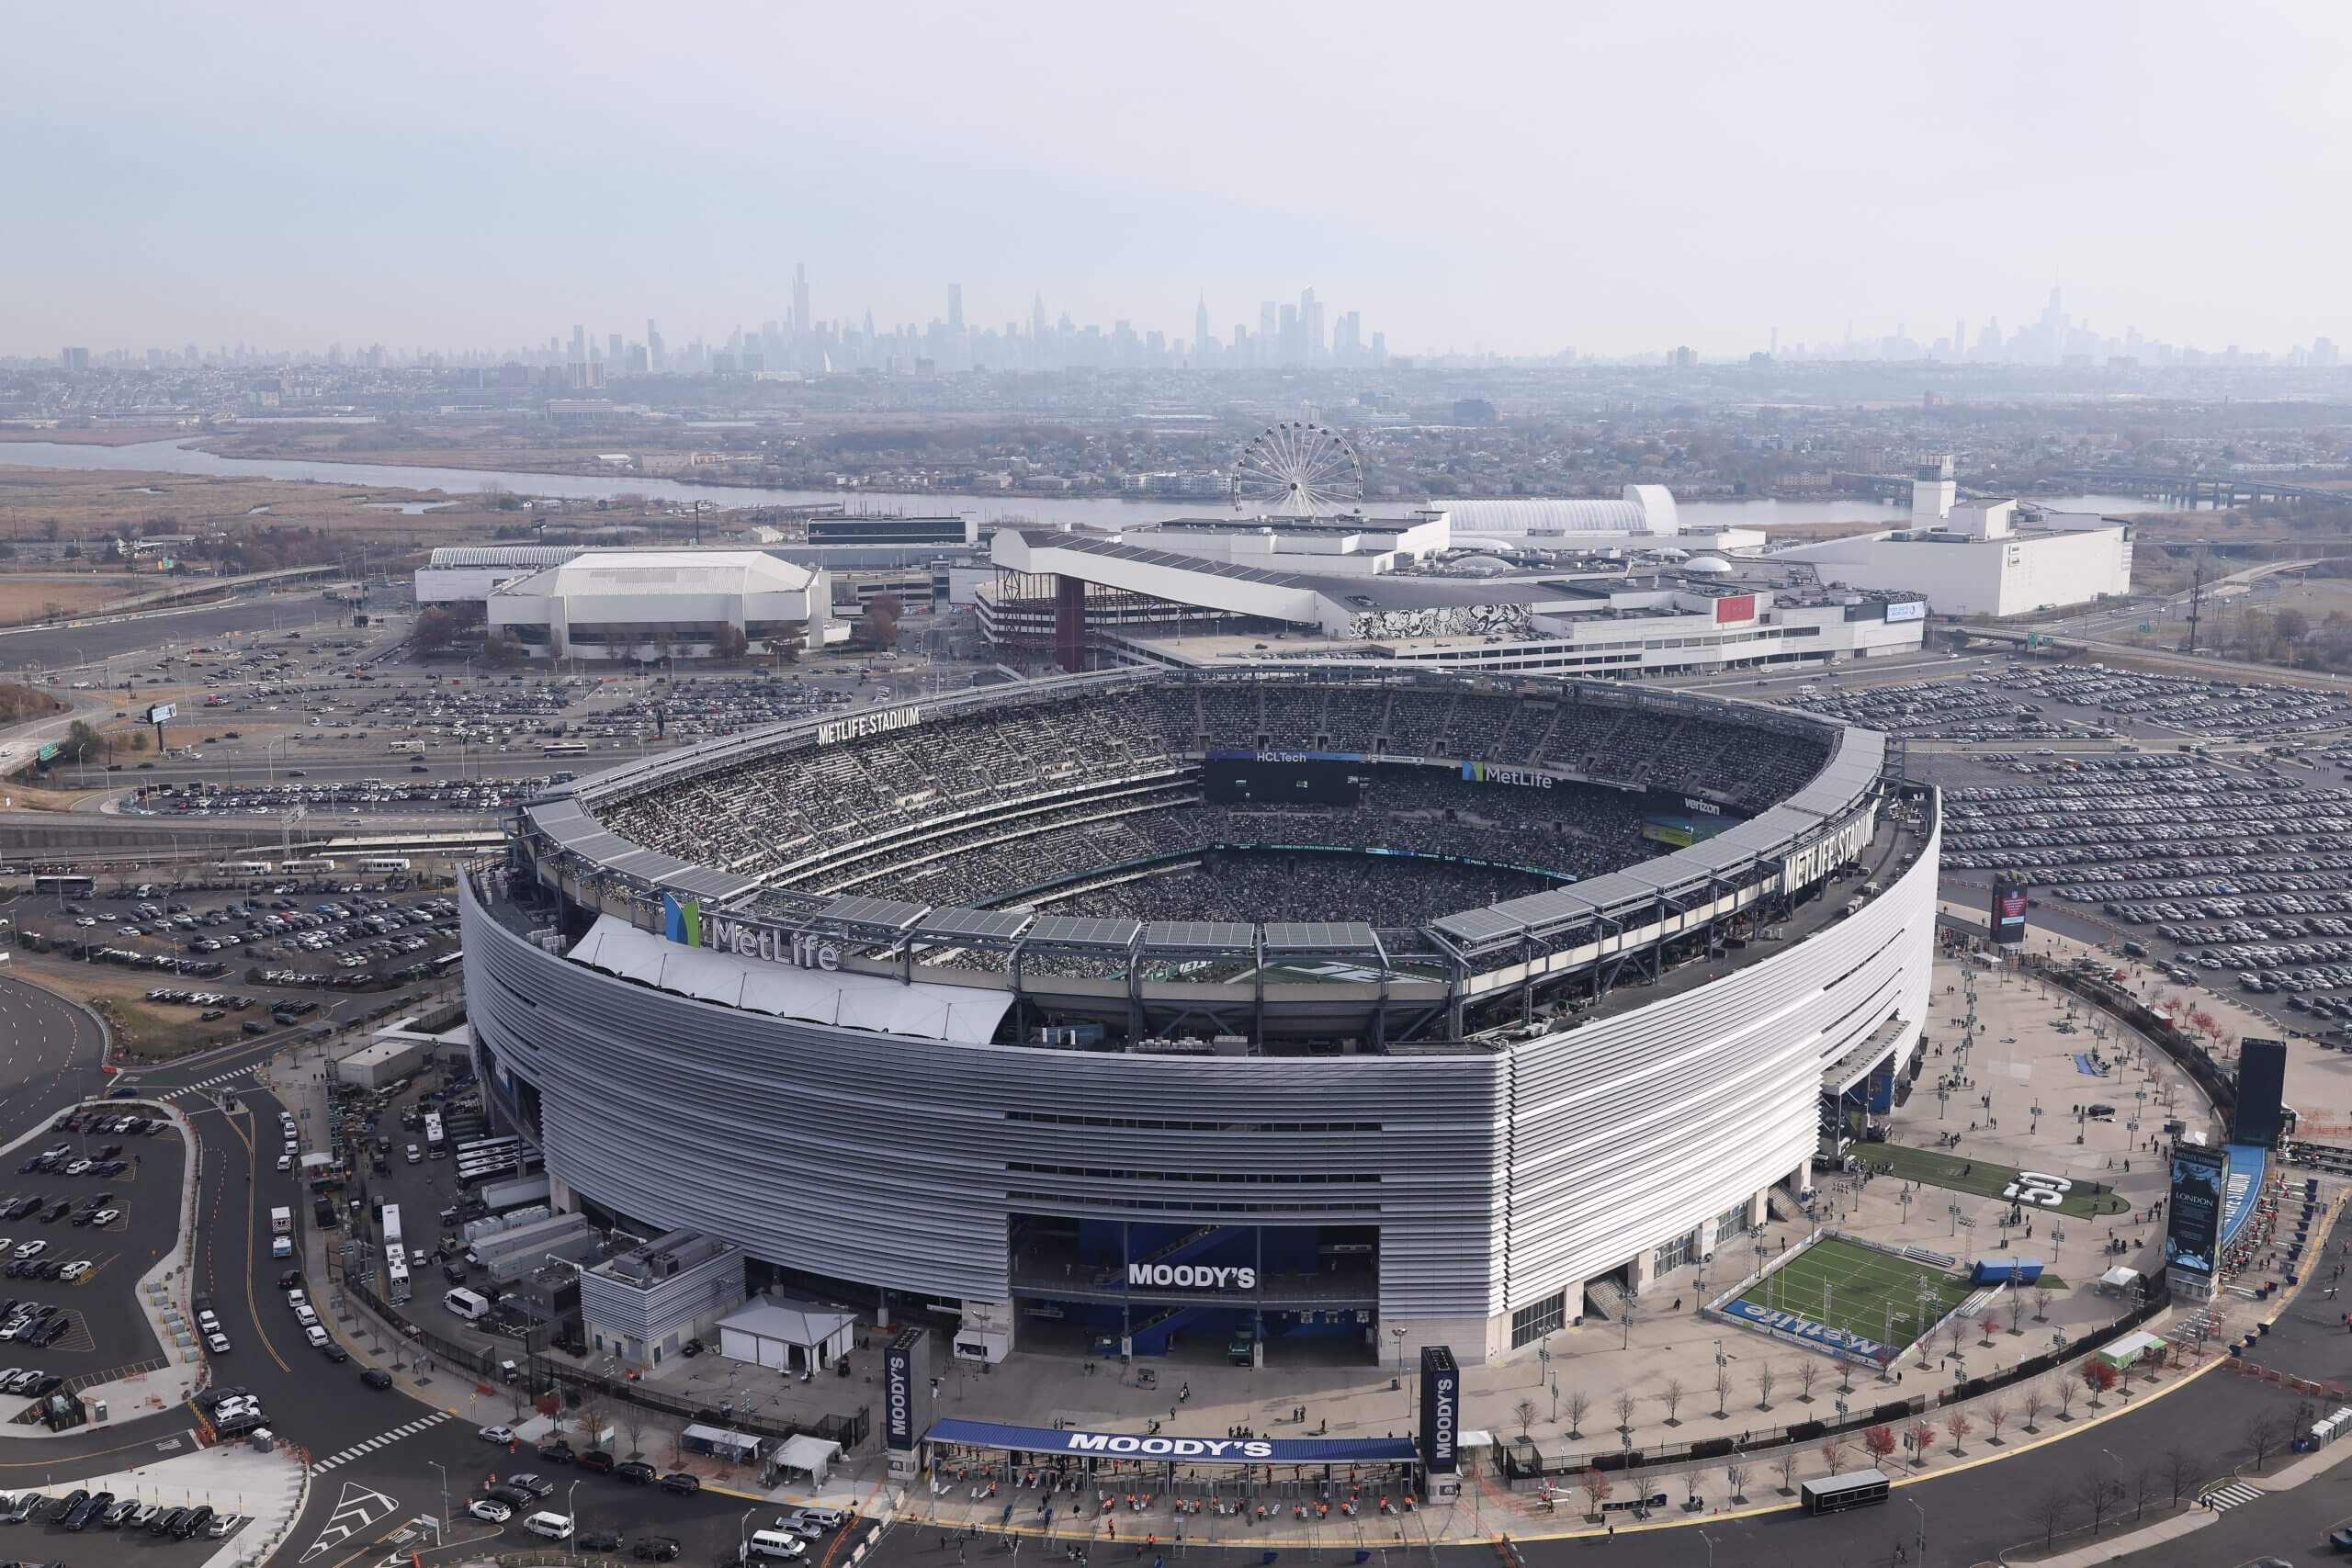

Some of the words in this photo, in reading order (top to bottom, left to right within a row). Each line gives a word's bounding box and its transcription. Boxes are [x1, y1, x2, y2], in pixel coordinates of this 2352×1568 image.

[817, 716, 866, 746] METLIFE
[869, 706, 920, 734] STADIUM
[1256, 751, 1307, 763] HCLTech
[1485, 766, 1553, 789] MetLife
[1684, 797, 1720, 816] verizon
[1784, 835, 1836, 896] METLIFE
[1838, 808, 1874, 866] STADIUM
[712, 917, 840, 972] MetLife
[2176, 1191, 2213, 1207] LONDON
[1128, 1263, 1256, 1289] MOODY'S
[890, 1357, 906, 1436] MOODY'S
[1436, 1378, 1453, 1459] MOODY'S
[1068, 1433, 1273, 1458] MOODY'S
